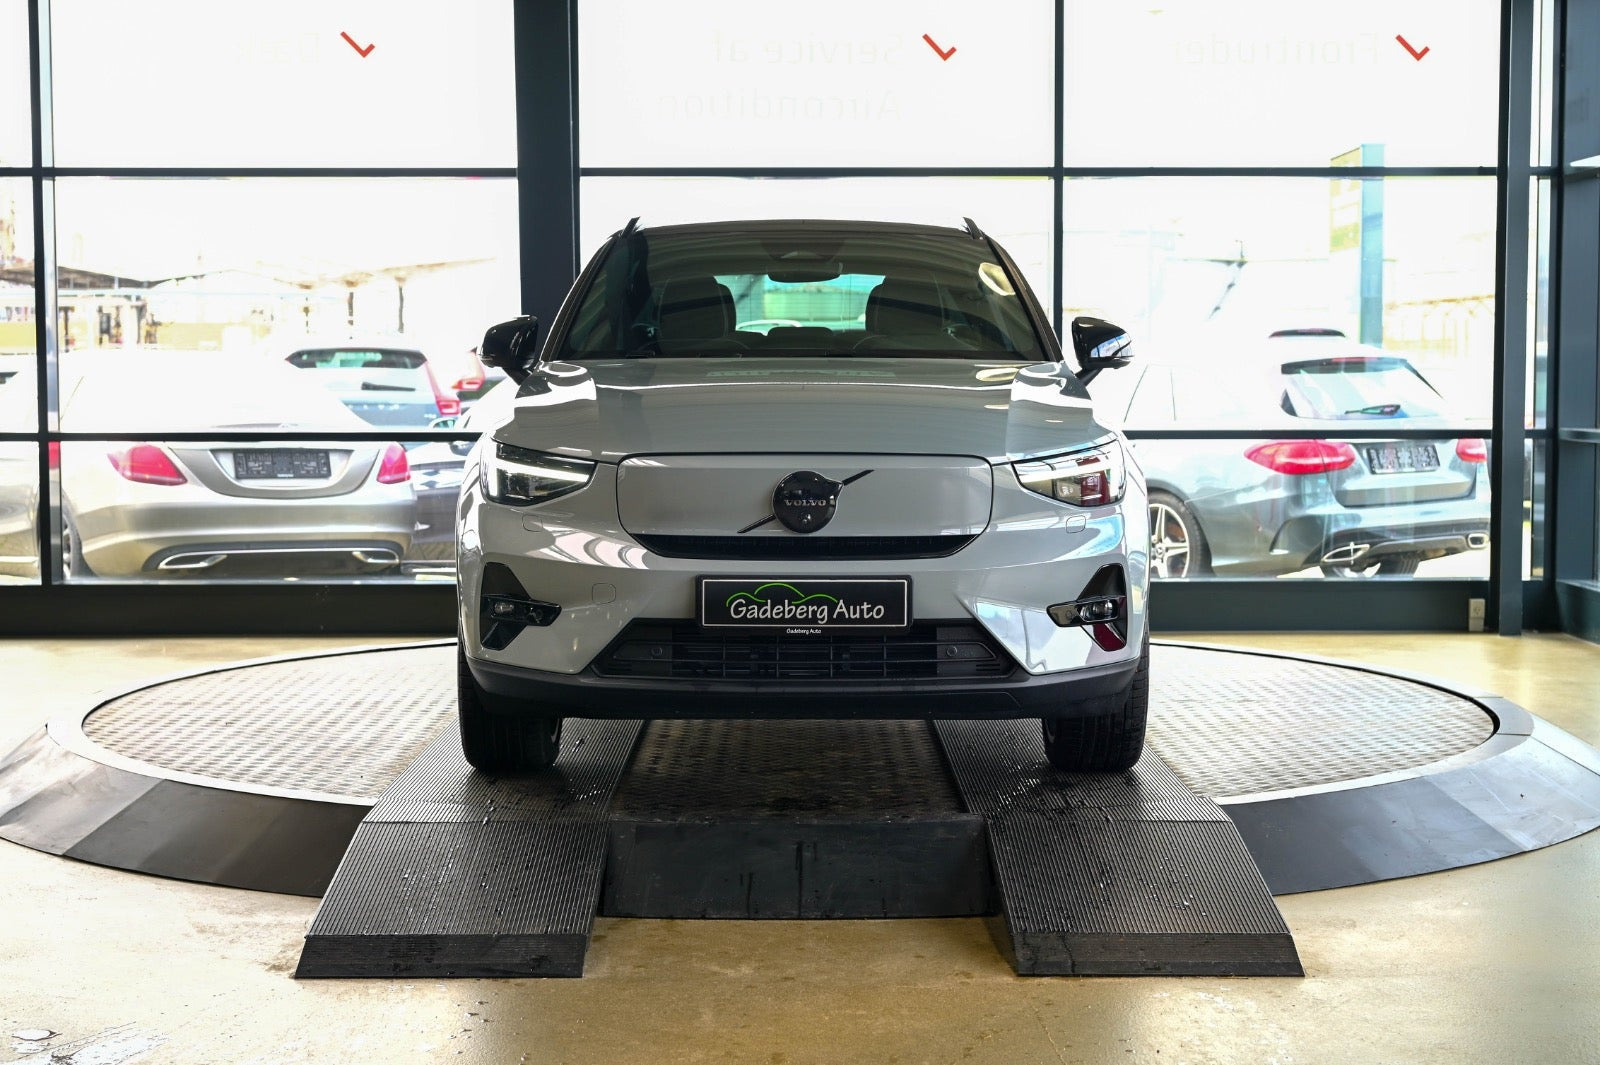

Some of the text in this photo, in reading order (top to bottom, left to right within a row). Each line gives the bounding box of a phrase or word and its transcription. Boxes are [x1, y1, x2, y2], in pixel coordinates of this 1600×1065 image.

[784, 499, 827, 507] VOLVO
[730, 599, 885, 624] Gadeberg Auto
